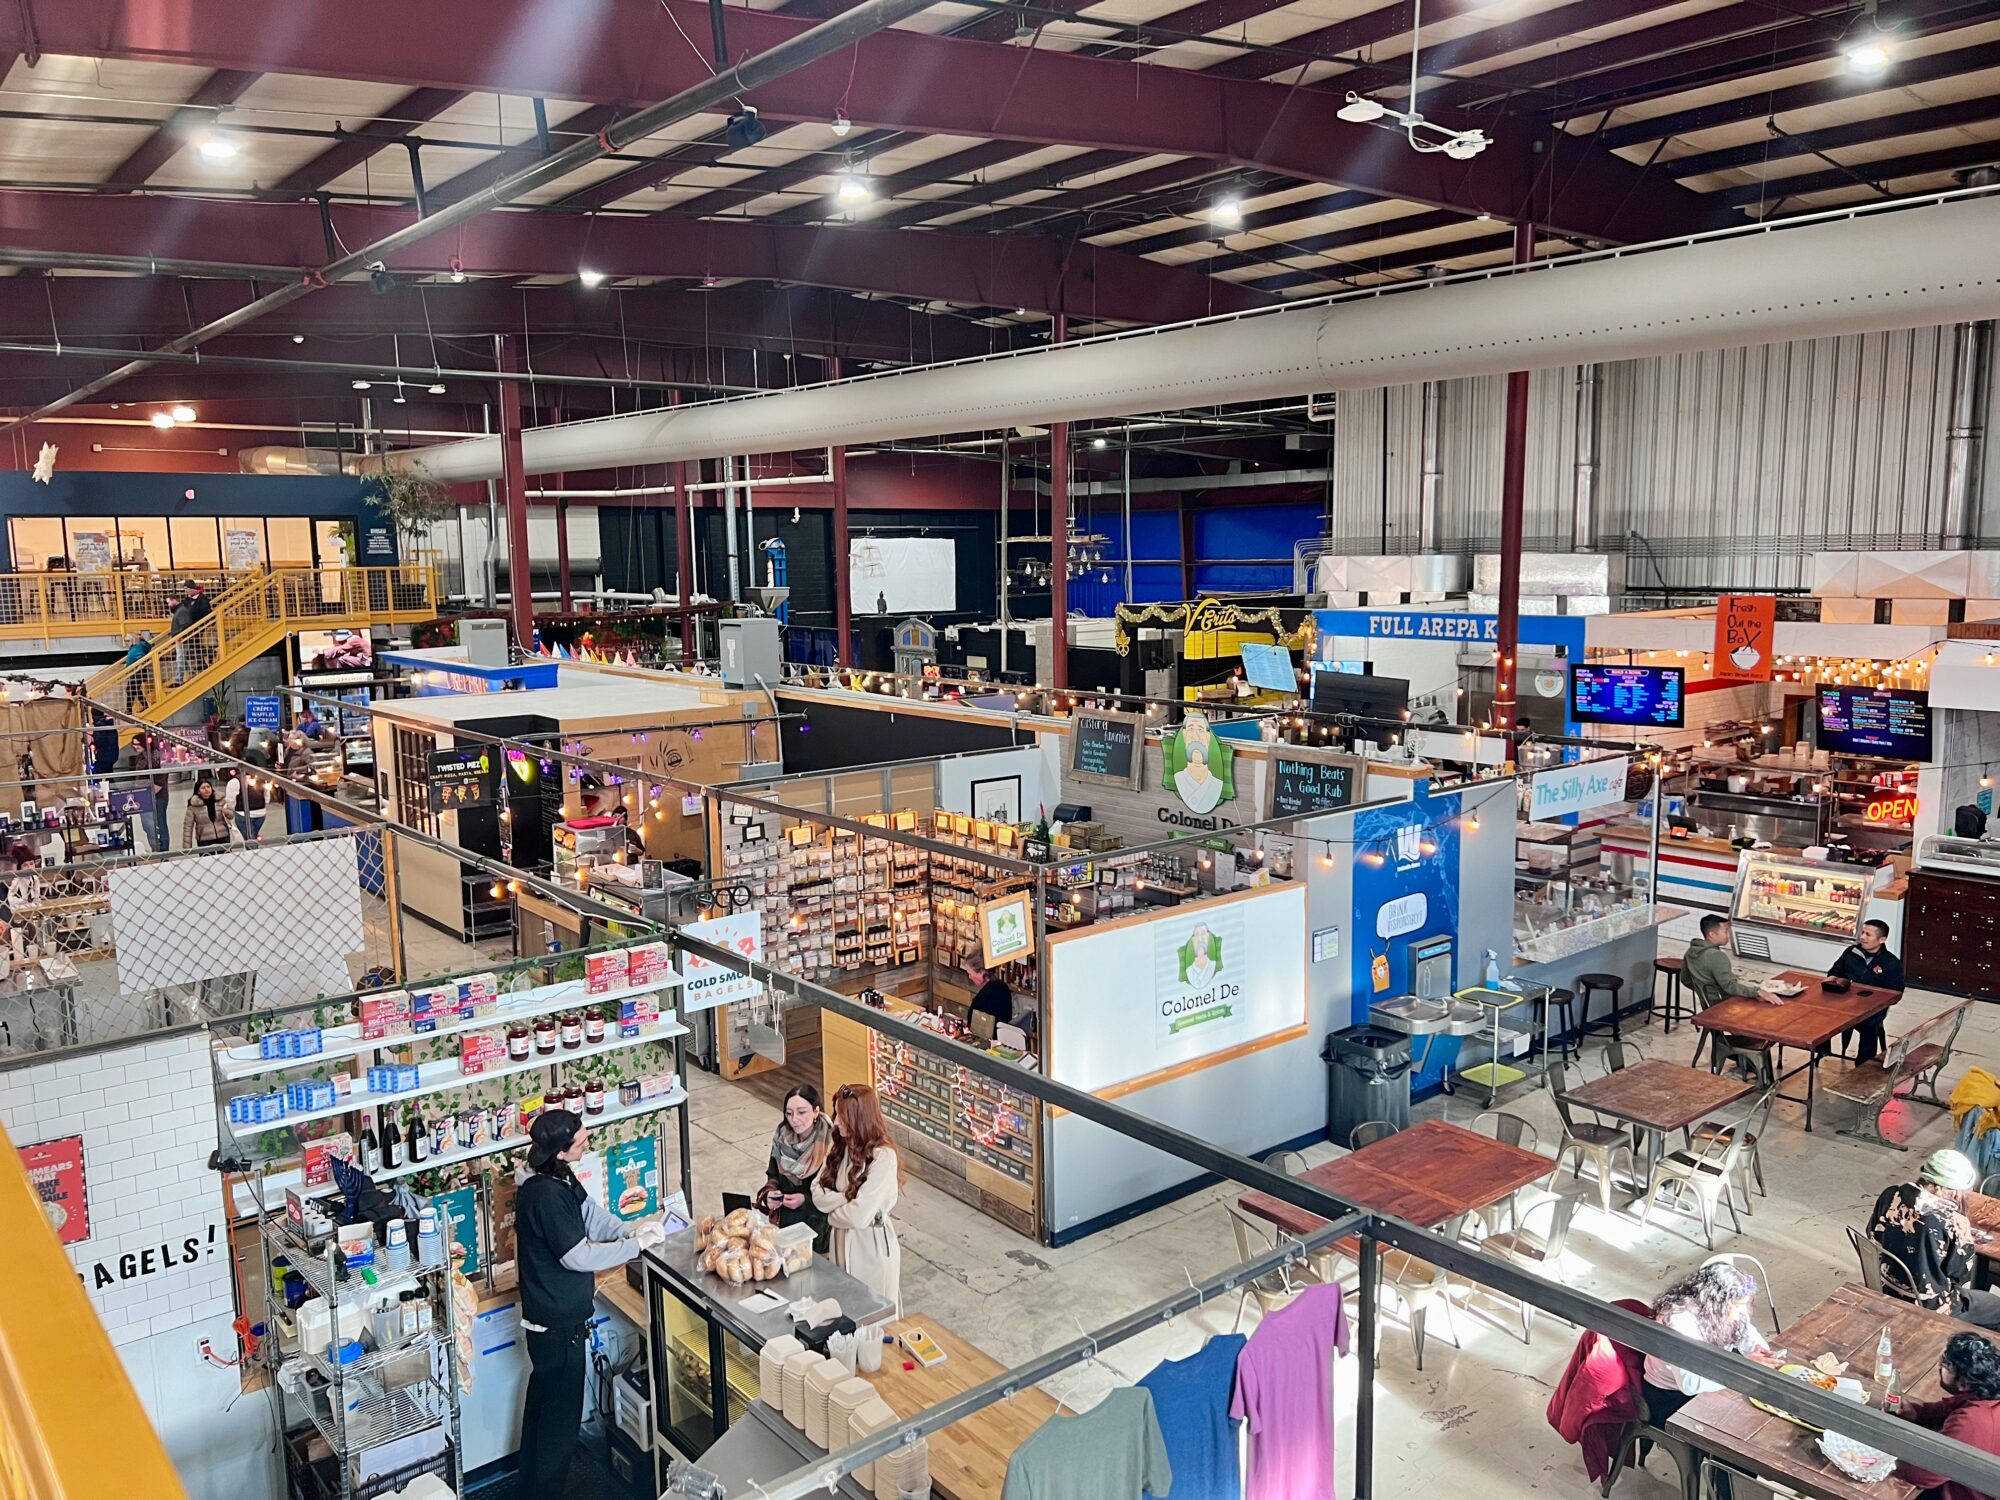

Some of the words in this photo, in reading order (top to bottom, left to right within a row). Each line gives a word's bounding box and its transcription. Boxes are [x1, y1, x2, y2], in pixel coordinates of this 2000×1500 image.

[1369, 615, 1414, 636] FULL
[1417, 617, 1480, 638] AREPA
[436, 762, 466, 773] TWISTED
[1280, 760, 1314, 784] Nothing
[1320, 765, 1346, 781] Beats
[1284, 778, 1292, 793] A
[1298, 780, 1321, 794] Good
[1324, 783, 1343, 798] Rub
[1536, 782, 1559, 806] The
[1560, 776, 1586, 803] Silly
[1586, 774, 1609, 796] Axe
[1867, 798, 1918, 820] OPEN
[1158, 808, 1217, 831] Colonel
[1388, 900, 1409, 919] DRINK
[687, 976, 716, 990] COLD
[720, 972, 746, 984] SMO
[694, 980, 753, 1001] BAGELS
[462, 996, 490, 1006] UNSALTED
[1162, 988, 1216, 1016] Colonel
[1220, 984, 1240, 1000] De
[385, 1014, 405, 1022] ONION
[423, 1008, 453, 1018] UNSALTED
[484, 1050, 502, 1058] ONION
[616, 1160, 648, 1176] PICKLED
[39, 1187, 56, 1196] OU
[42, 1192, 68, 1202] MILE
[77, 1224, 216, 1290] AGELS!
